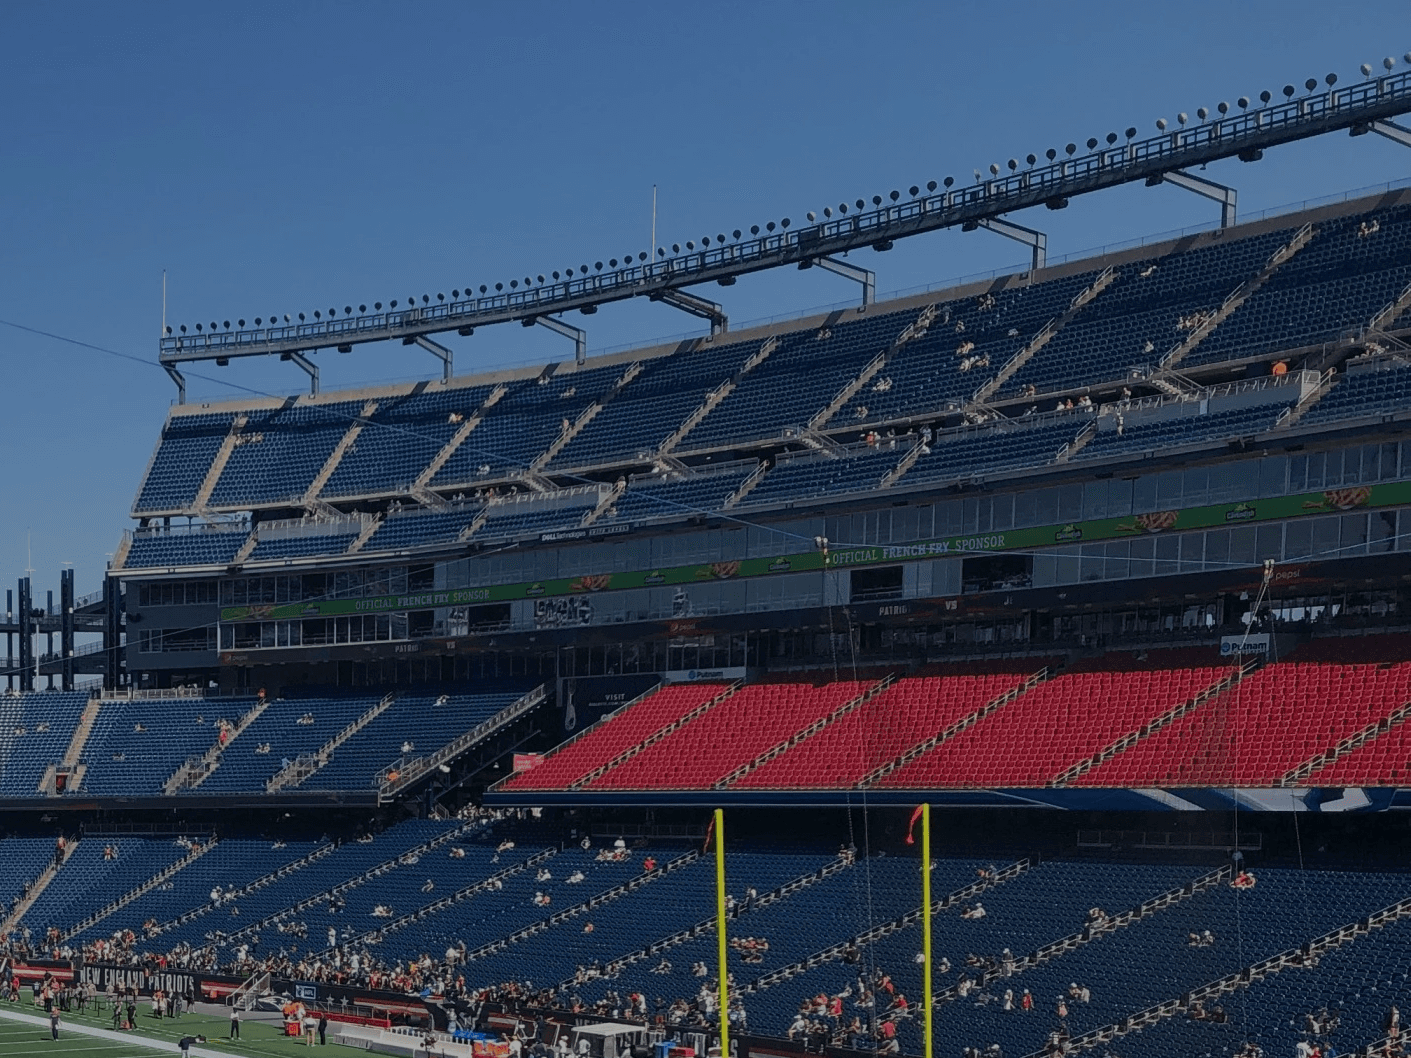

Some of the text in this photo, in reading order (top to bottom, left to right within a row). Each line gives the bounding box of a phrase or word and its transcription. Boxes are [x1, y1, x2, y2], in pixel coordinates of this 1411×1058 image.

[832, 535, 1006, 565] OFFICIAL FRENCH FRY SPONSOR
[355, 589, 490, 610] OFFICIAL FRENCH FRY SPONSOR
[604, 693, 626, 701] VISIT
